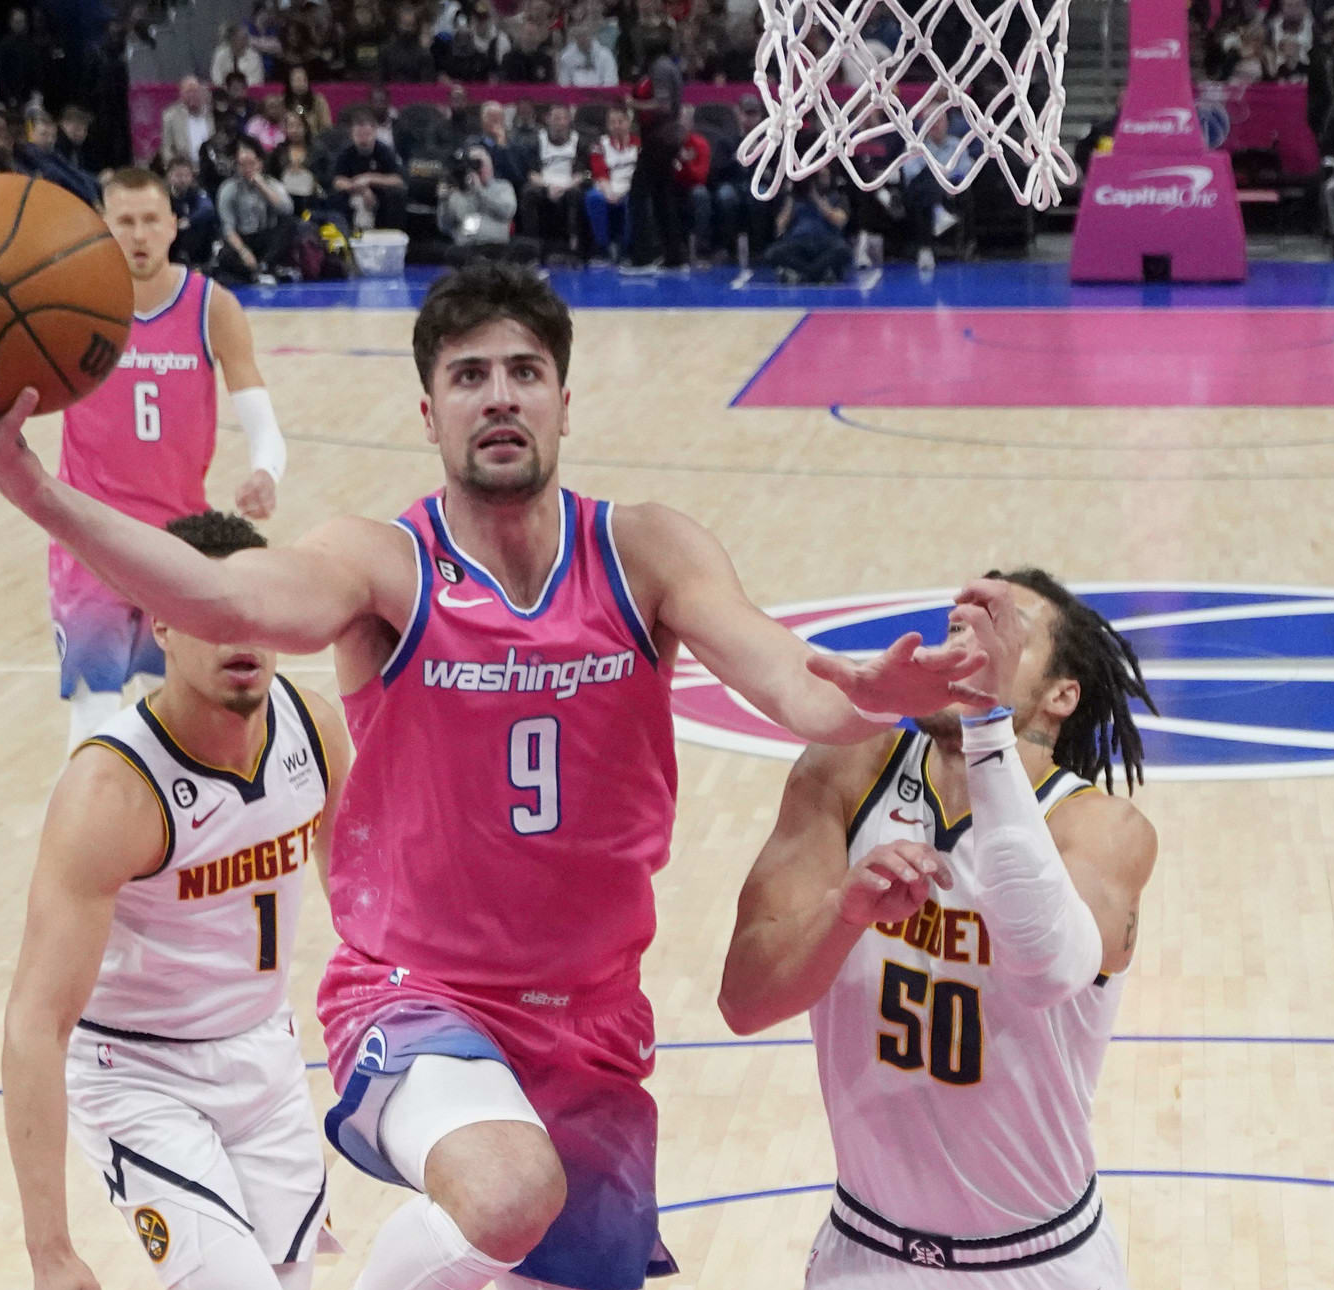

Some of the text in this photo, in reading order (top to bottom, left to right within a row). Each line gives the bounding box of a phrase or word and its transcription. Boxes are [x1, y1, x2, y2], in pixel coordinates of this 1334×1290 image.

[117, 343, 199, 376] shington
[133, 380, 162, 442] 6
[436, 559, 458, 584] 6
[423, 645, 636, 700] washington
[283, 748, 308, 773] WU
[507, 714, 561, 837] 9
[175, 780, 193, 808] 6
[252, 890, 278, 973] 1
[876, 958, 985, 1086] 50
